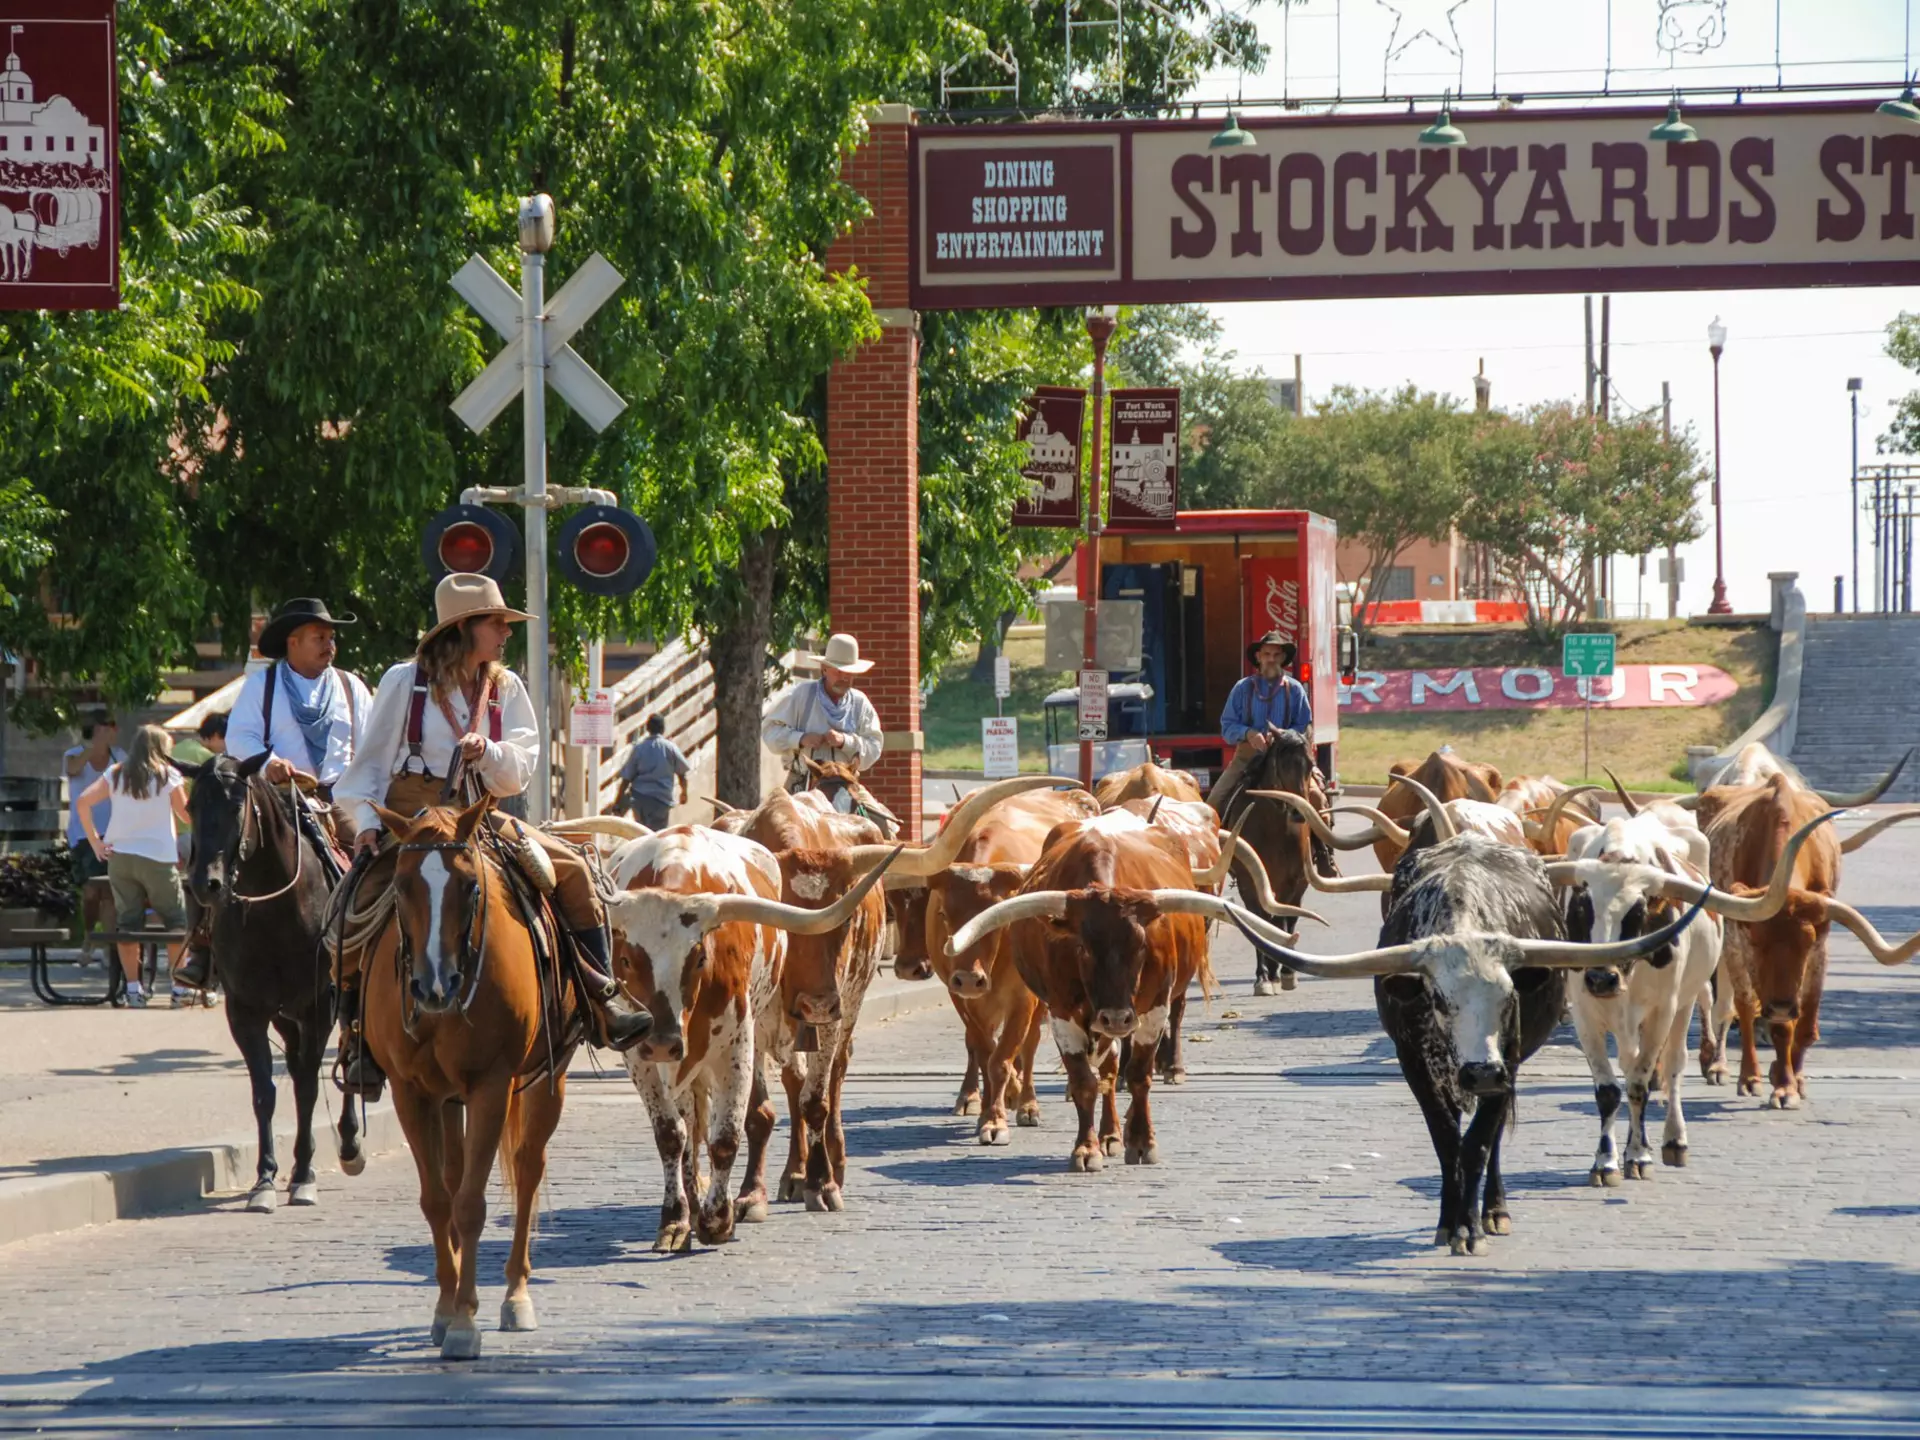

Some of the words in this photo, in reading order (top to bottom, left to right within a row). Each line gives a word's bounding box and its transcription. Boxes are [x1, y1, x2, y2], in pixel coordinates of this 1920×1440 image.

[984, 160, 1055, 188] DINING
[972, 195, 1068, 224] SHOPPING
[1171, 136, 1777, 260] STOCKYARDS
[1816, 133, 1920, 243] ST
[936, 230, 1104, 259] ENTERTAINMENT
[1117, 410, 1173, 419] STOCKYARDS
[1125, 402, 1141, 410] Fort
[1144, 402, 1166, 410] Worth
[1088, 674, 1100, 683] NO
[1337, 665, 1699, 704] RMOUR
[986, 728, 1014, 736] PARKING
